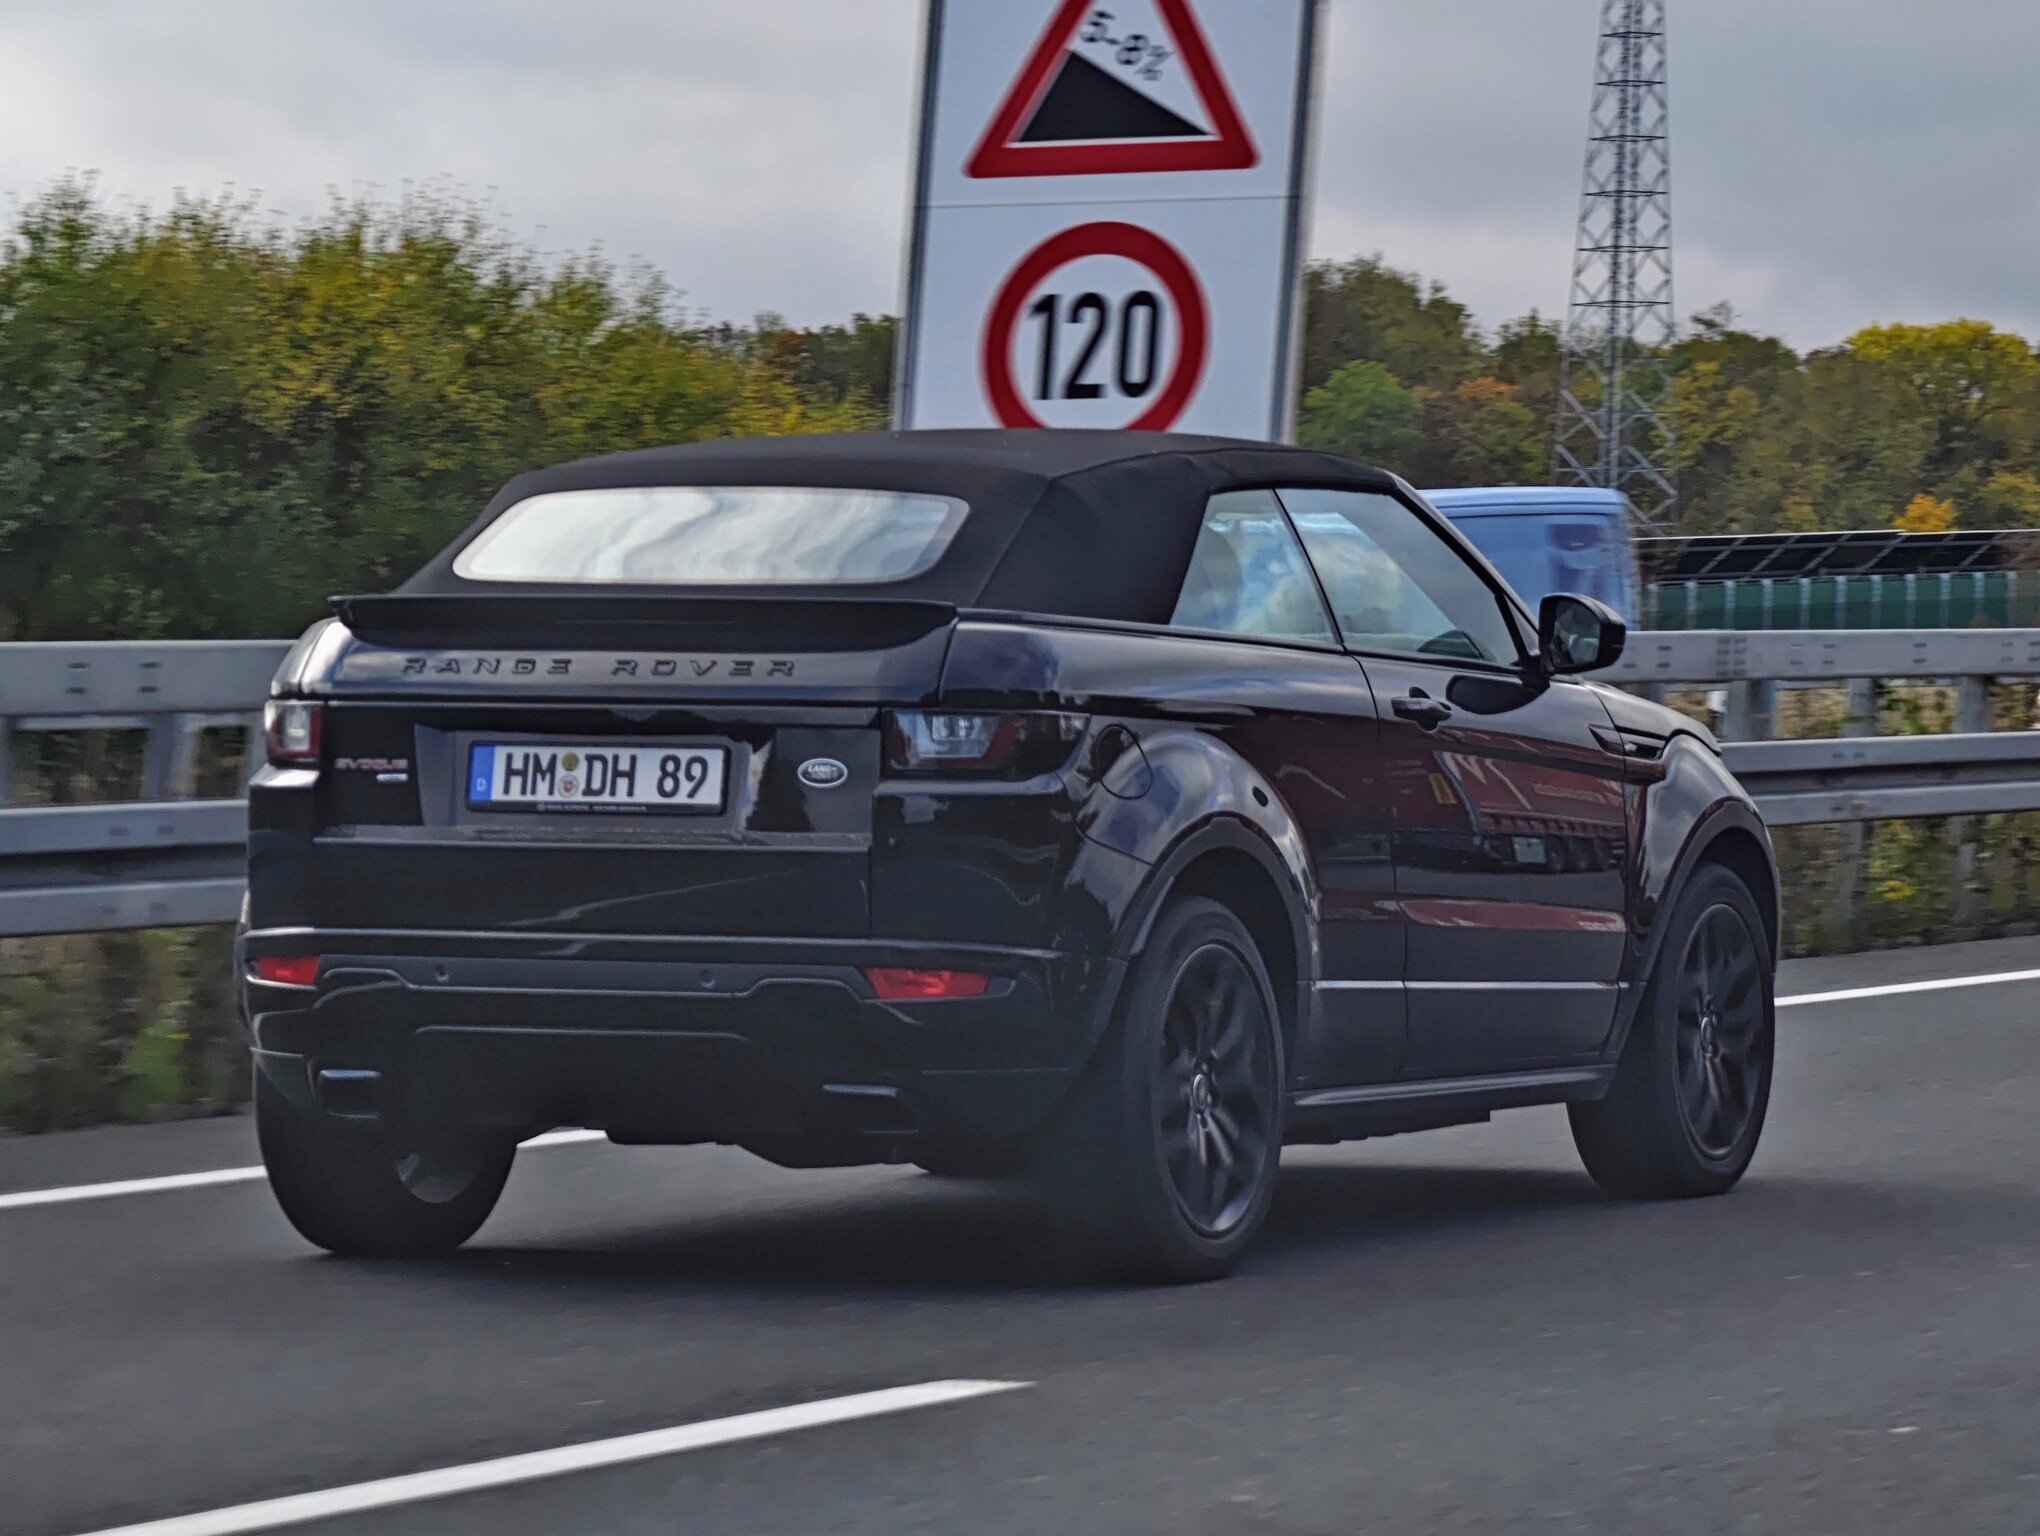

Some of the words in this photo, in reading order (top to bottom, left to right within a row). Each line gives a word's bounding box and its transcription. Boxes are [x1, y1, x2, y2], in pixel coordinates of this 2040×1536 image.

[1081, 9, 1174, 81] 5-8%
[1027, 290, 1162, 400] 120
[402, 657, 573, 675] RANGE
[611, 659, 795, 677] ROVER
[476, 777, 487, 792] D
[502, 752, 557, 796] HM
[582, 753, 637, 797] DH
[656, 754, 708, 799] 89
